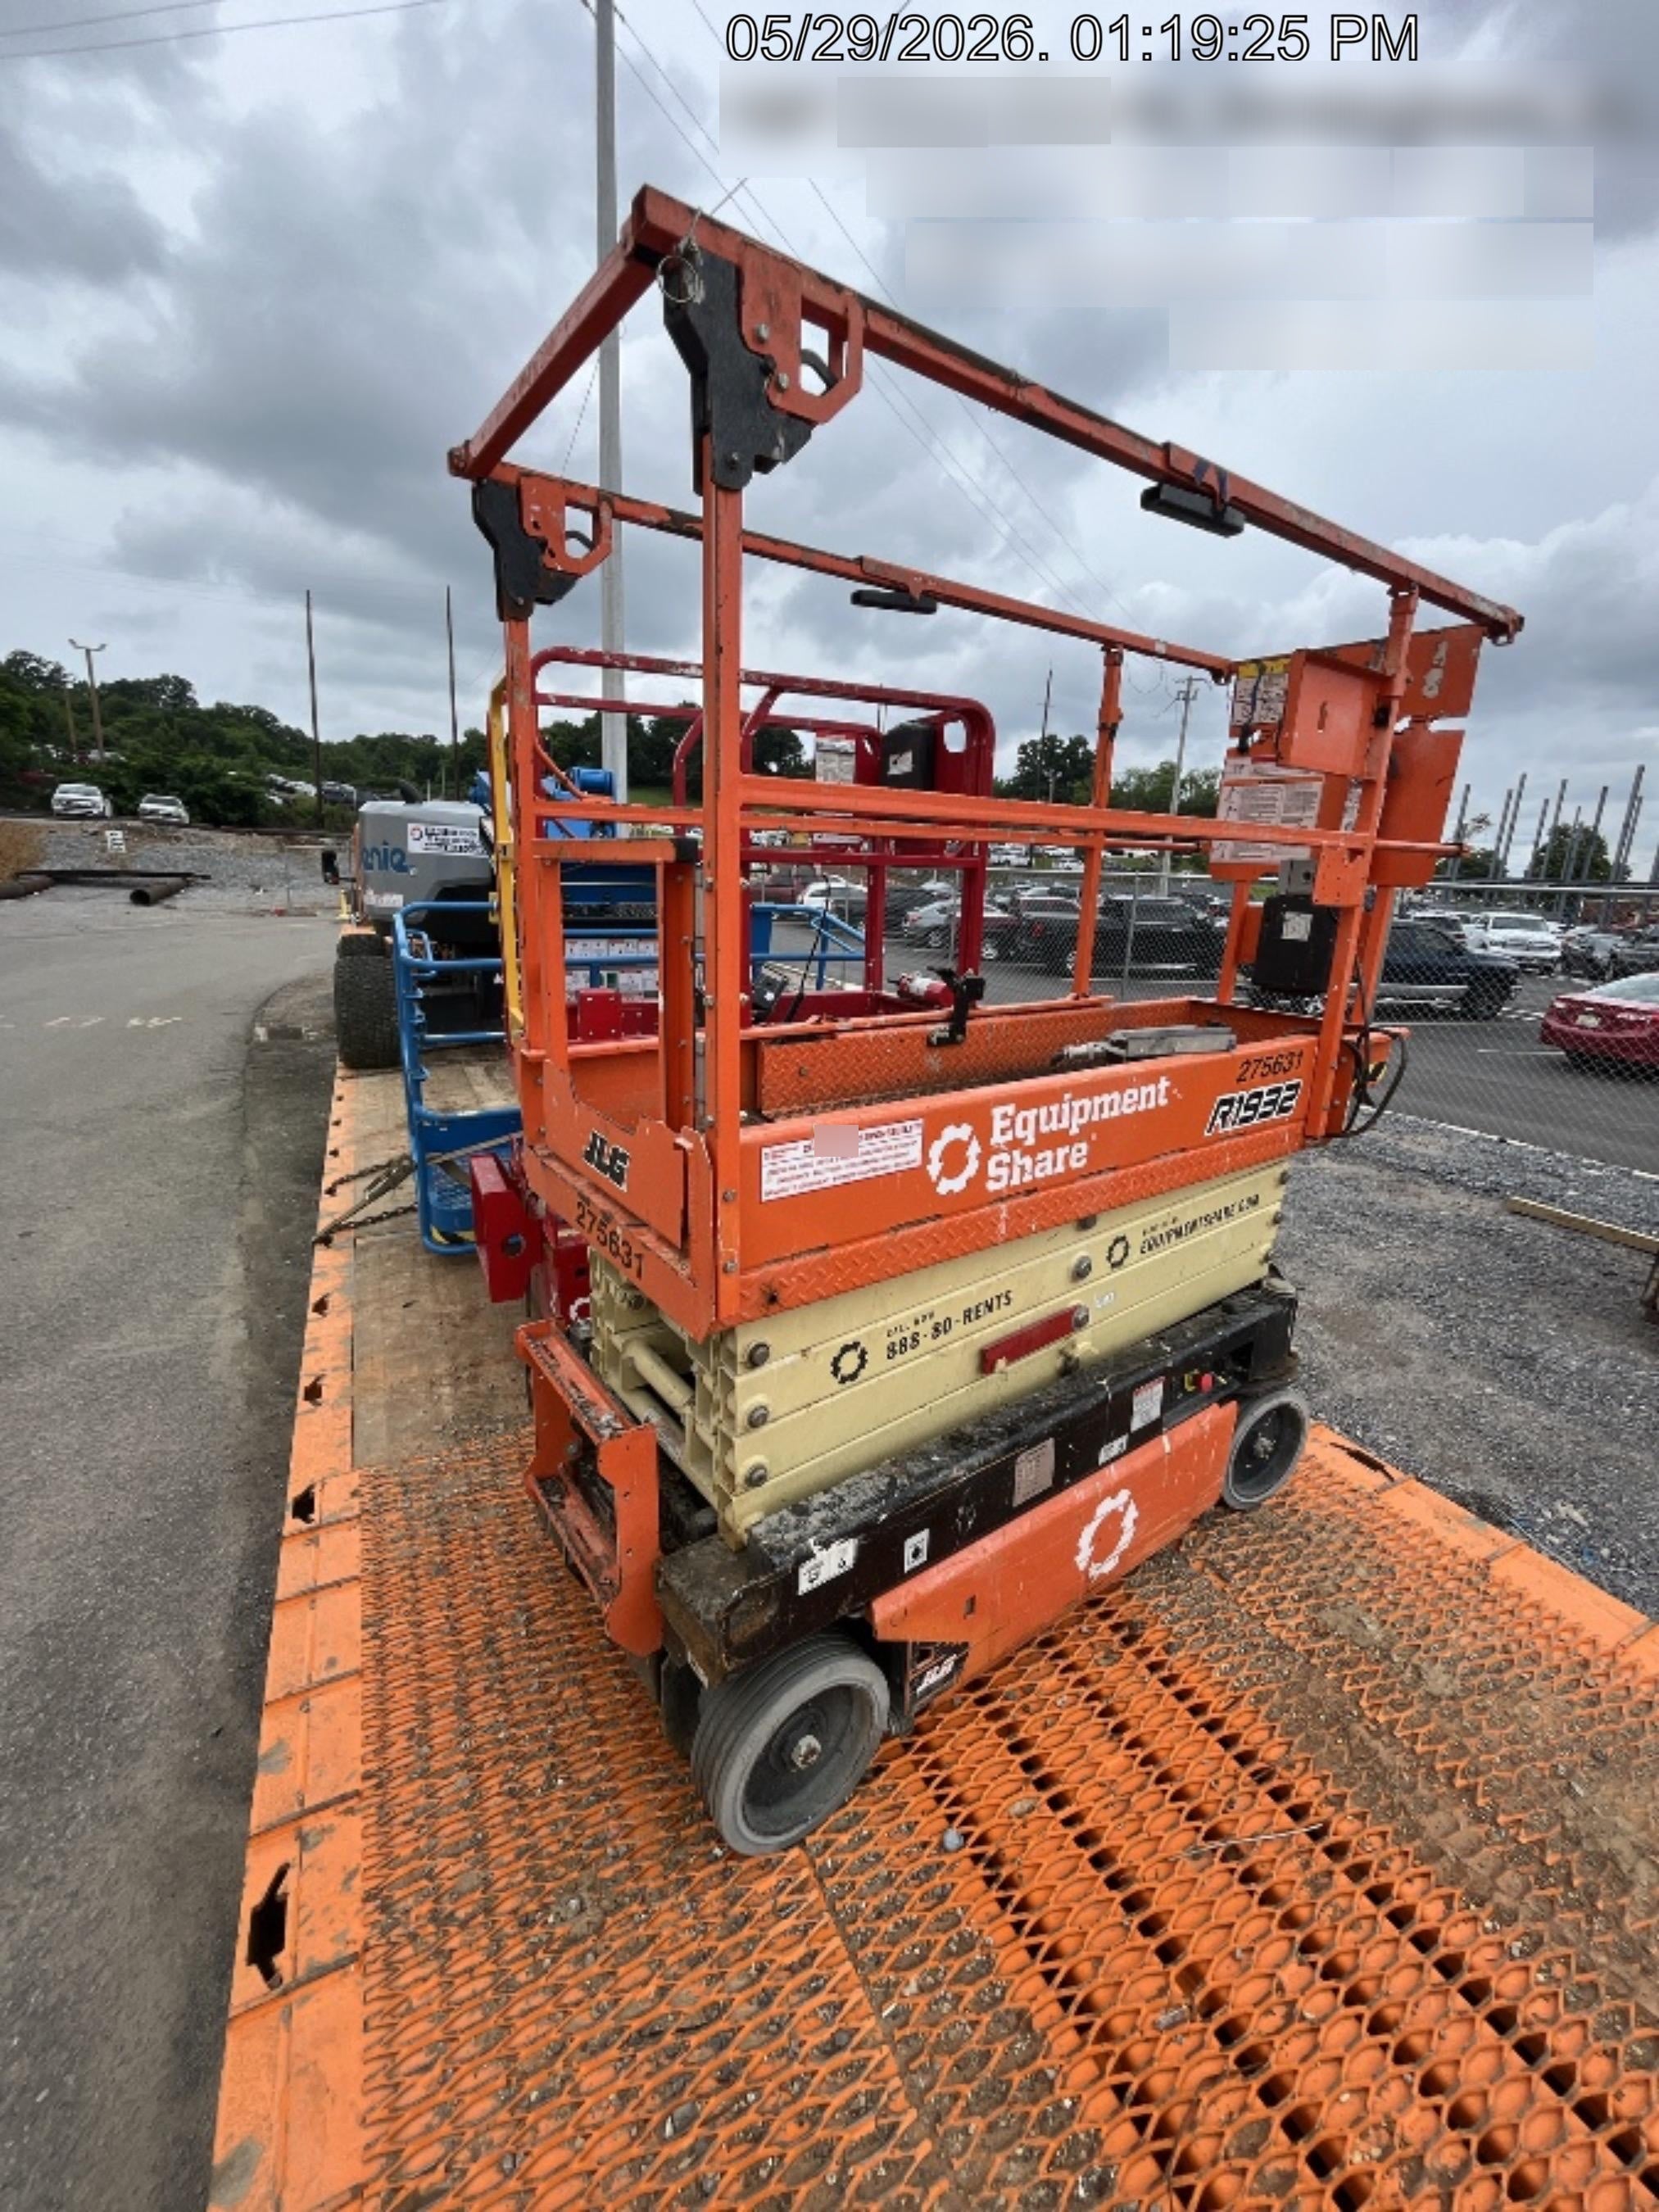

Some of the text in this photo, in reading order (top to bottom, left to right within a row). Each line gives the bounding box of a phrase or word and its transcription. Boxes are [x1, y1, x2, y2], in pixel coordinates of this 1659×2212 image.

[1235, 1049, 1304, 1084] 275631
[989, 1076, 1172, 1147] Equipment
[1204, 1078, 1303, 1136] R1932
[582, 1127, 631, 1194] JLG
[985, 1140, 1089, 1192] Share
[575, 1198, 644, 1281] 275631
